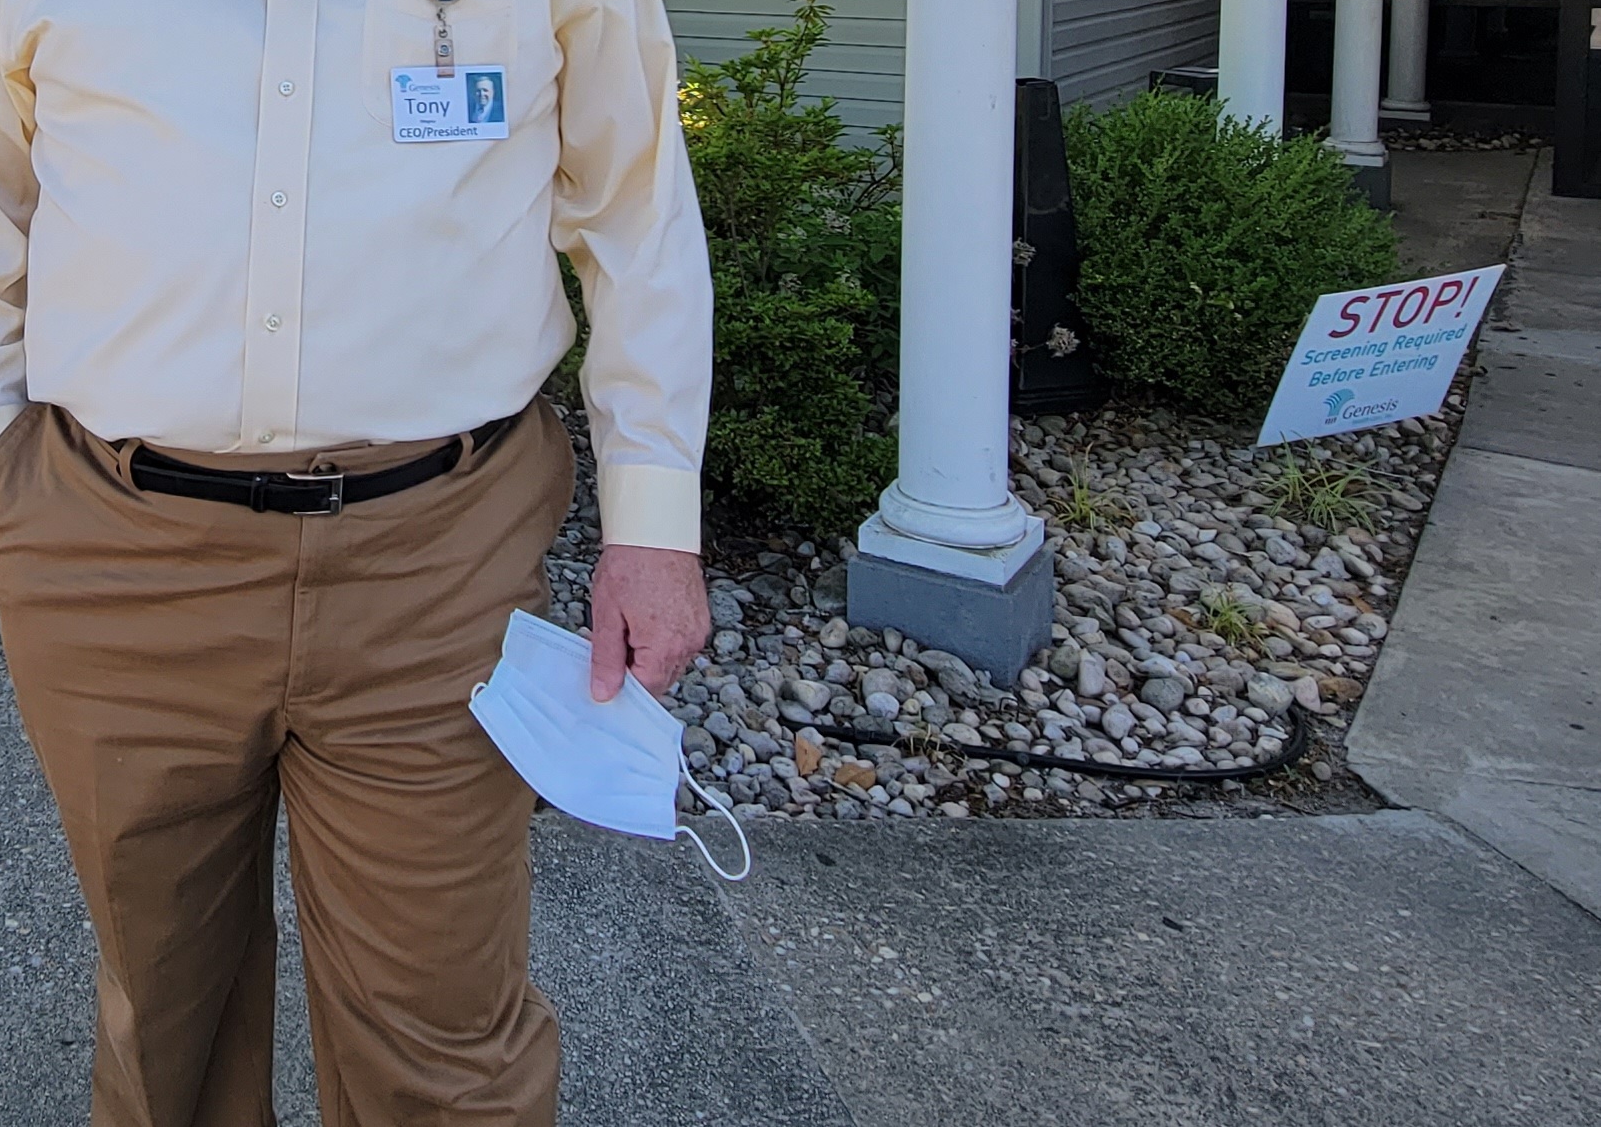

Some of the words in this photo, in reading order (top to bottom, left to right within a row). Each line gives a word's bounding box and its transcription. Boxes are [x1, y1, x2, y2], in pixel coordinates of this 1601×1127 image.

[403, 98, 450, 117] Tony
[399, 126, 478, 139] CEO/President
[1328, 276, 1480, 339] STOP!
[1301, 340, 1388, 365] Screening
[1392, 324, 1467, 351] Required
[1308, 367, 1368, 387] Before
[1369, 353, 1439, 378] Entering
[1342, 398, 1398, 420] Genesis
